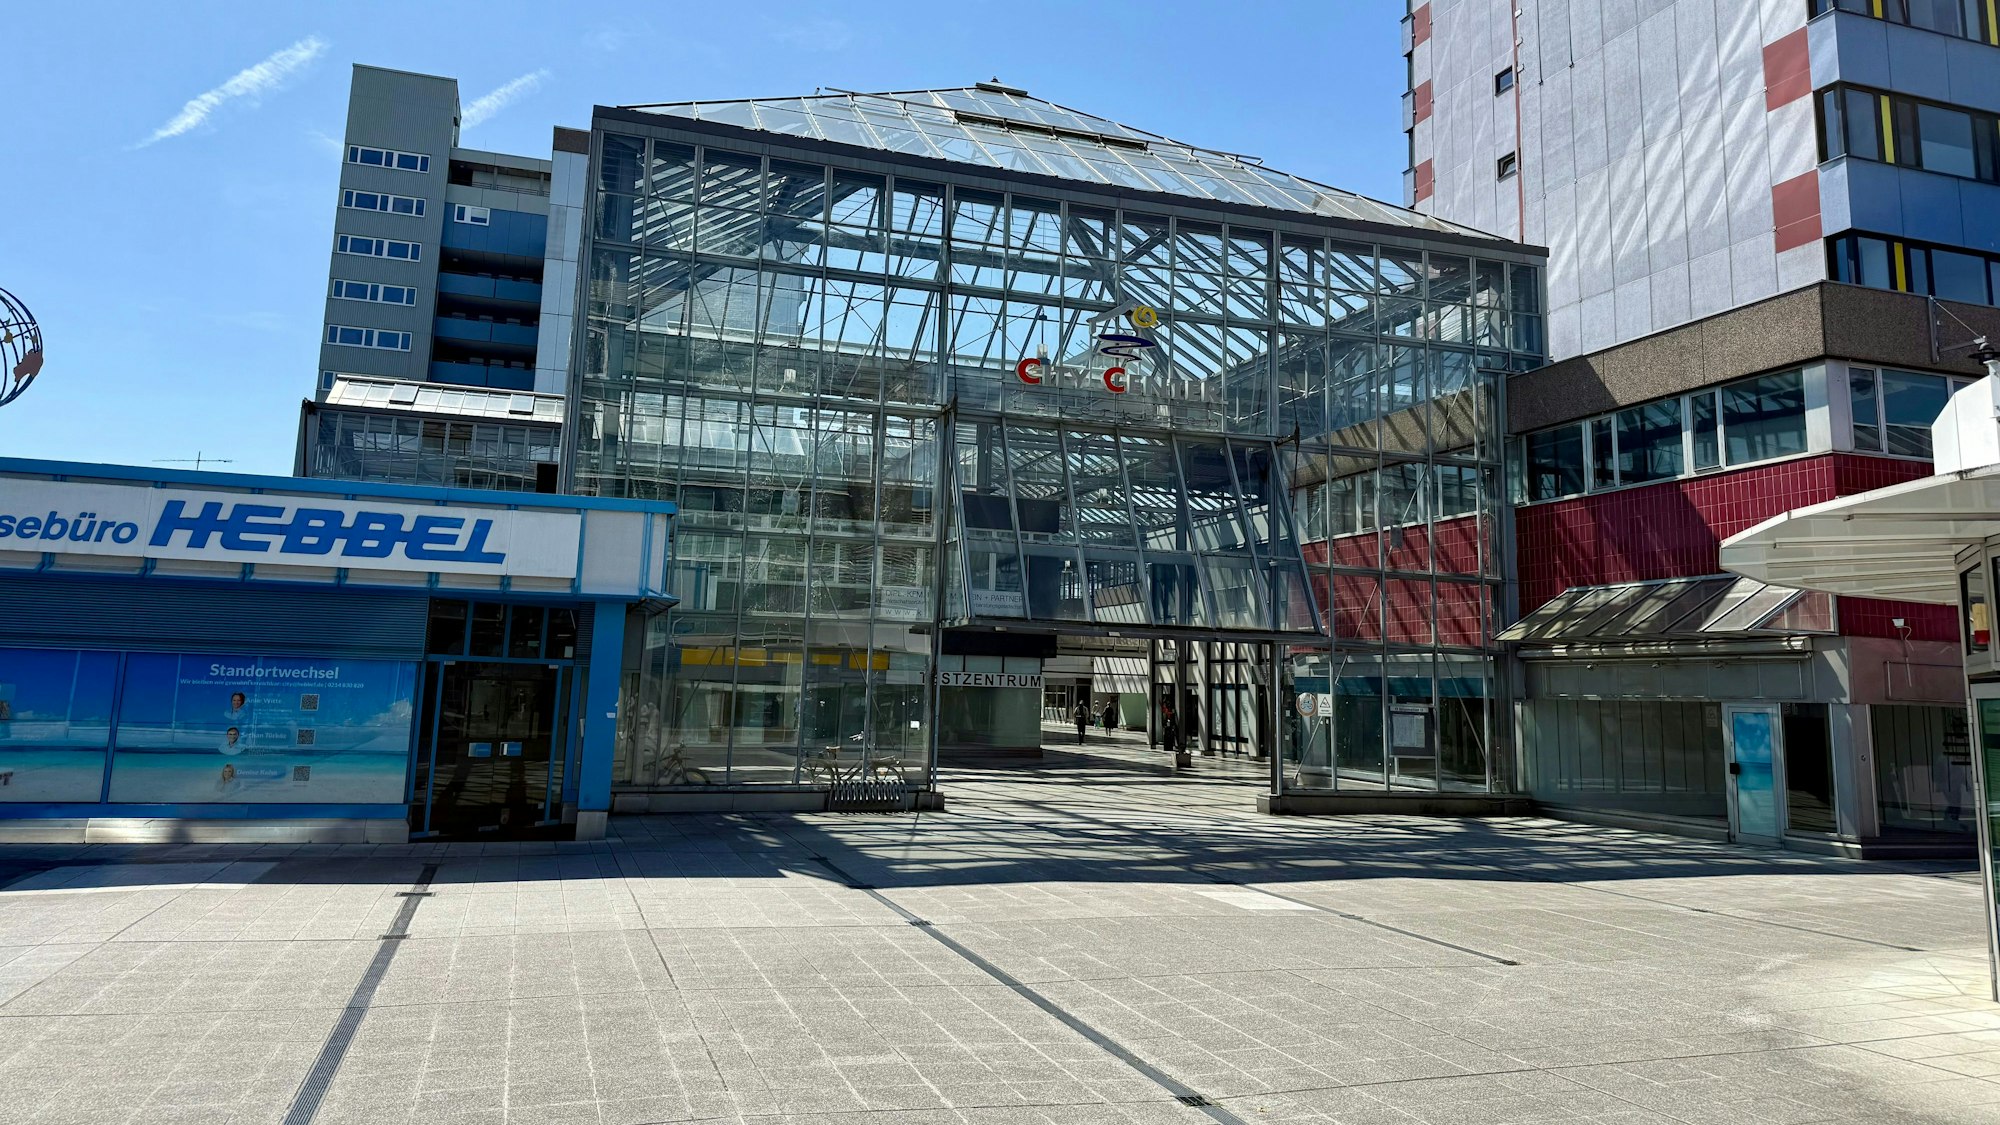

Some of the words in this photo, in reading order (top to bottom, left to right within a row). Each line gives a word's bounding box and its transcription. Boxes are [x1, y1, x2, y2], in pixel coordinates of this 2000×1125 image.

[1015, 358, 1090, 389] CITY
[1102, 367, 1224, 402] CENTER
[0, 511, 139, 544] sebüro
[149, 500, 506, 564] HEBBEL
[209, 663, 339, 679] Standortwechsel
[920, 672, 1041, 687] TSTZENTRUM
